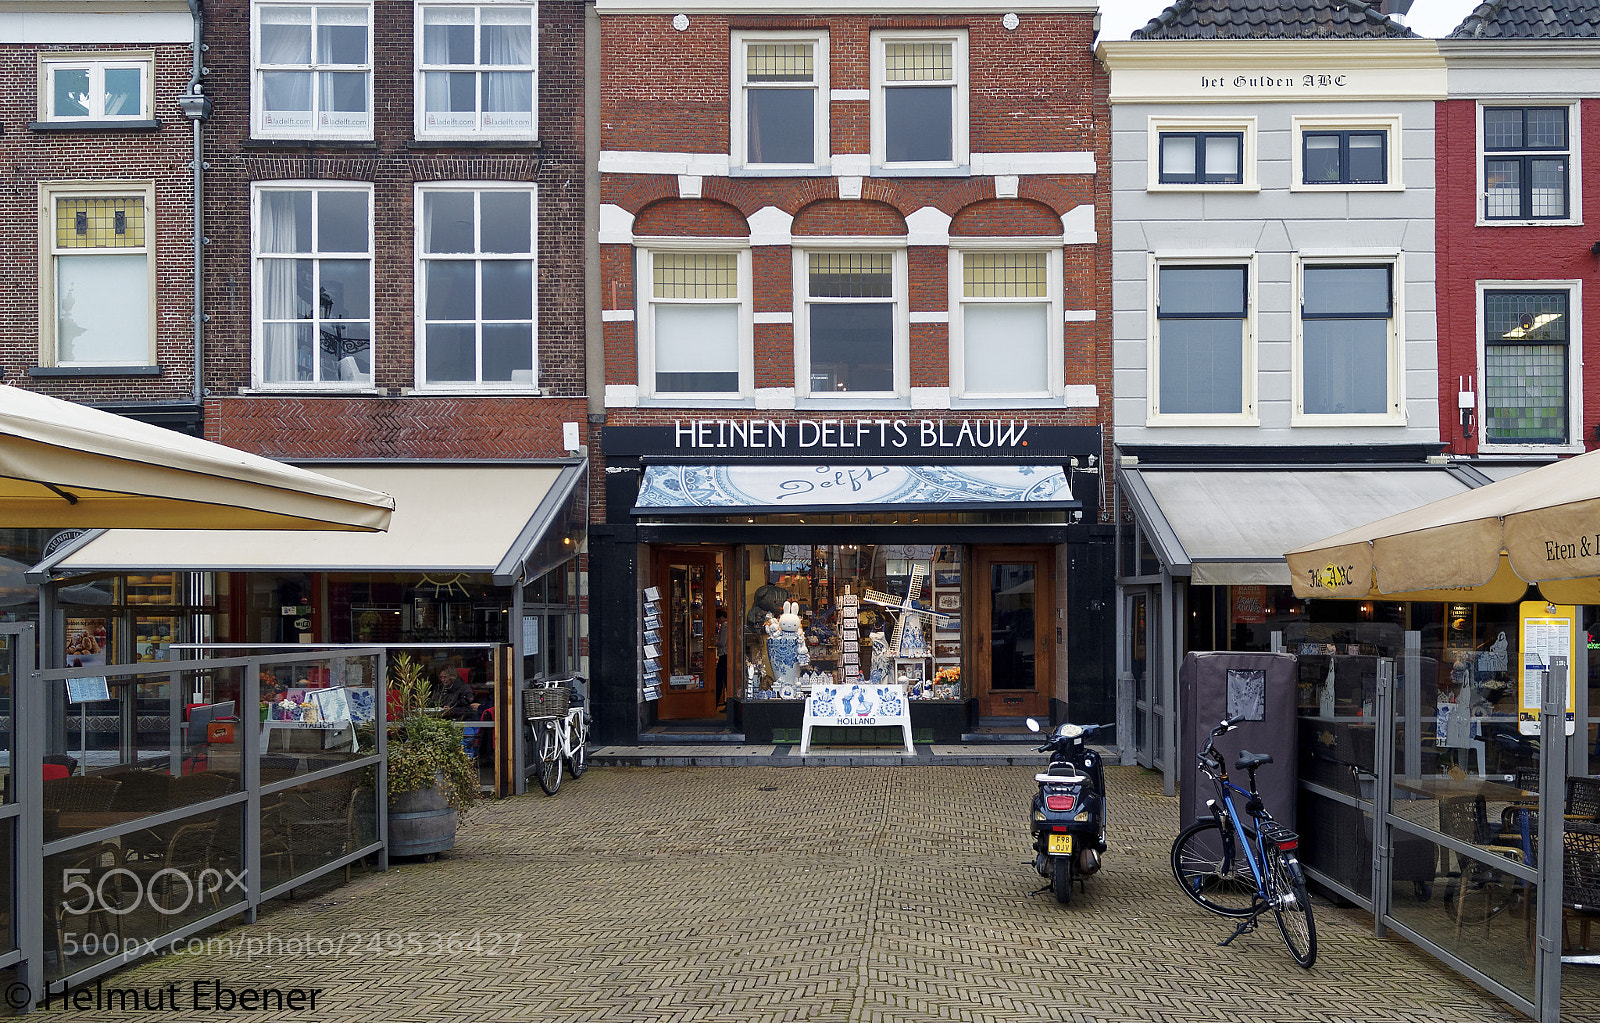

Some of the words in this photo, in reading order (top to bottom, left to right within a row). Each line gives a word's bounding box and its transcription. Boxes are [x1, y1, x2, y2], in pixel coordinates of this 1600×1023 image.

[1201, 76, 1225, 89] het
[1233, 75, 1294, 88] Gulden
[1302, 74, 1348, 88] ABC
[675, 419, 786, 448] HEINEN
[799, 419, 908, 448] DELFTS
[48, 531, 72, 552] HENRI
[1544, 540, 1577, 561] Eten
[1580, 535, 1592, 557] &
[837, 717, 876, 725] HOLLAND
